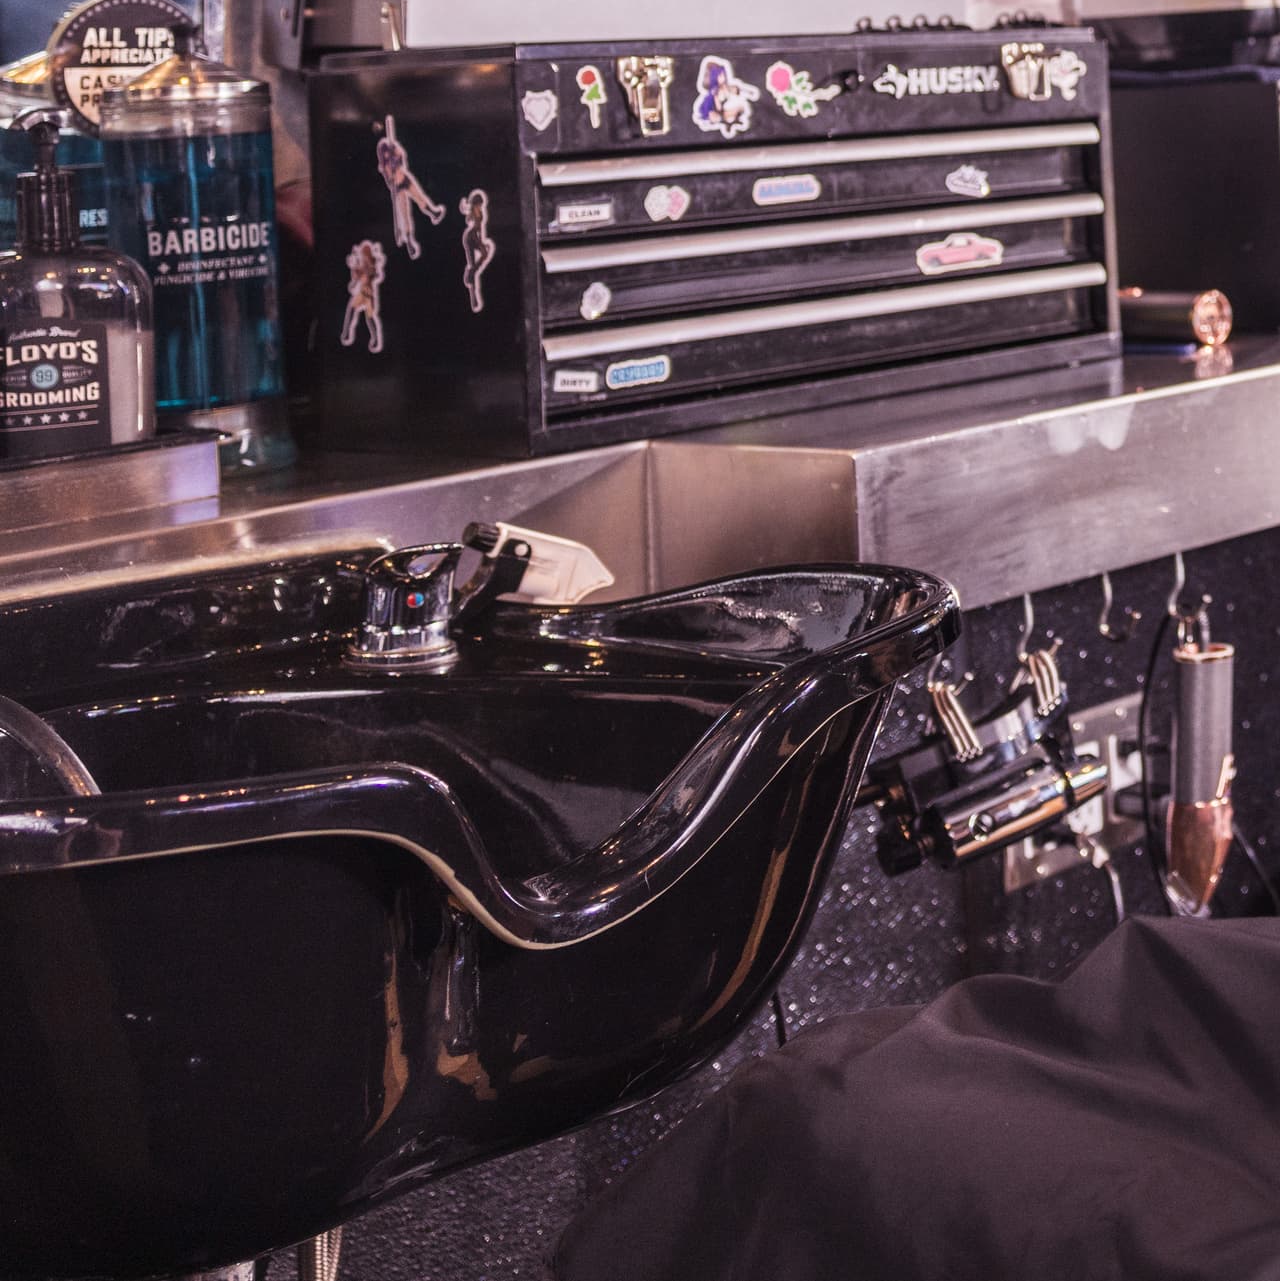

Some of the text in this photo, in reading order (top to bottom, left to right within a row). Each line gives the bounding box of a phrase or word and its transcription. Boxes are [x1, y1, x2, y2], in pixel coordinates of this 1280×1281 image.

[83, 27, 127, 49] ALL
[80, 47, 174, 65] APPRECIAT
[80, 75, 127, 91] CAS
[908, 65, 998, 95] HUSKY
[147, 222, 270, 257] BARBICIDE
[35, 369, 54, 384] 99
